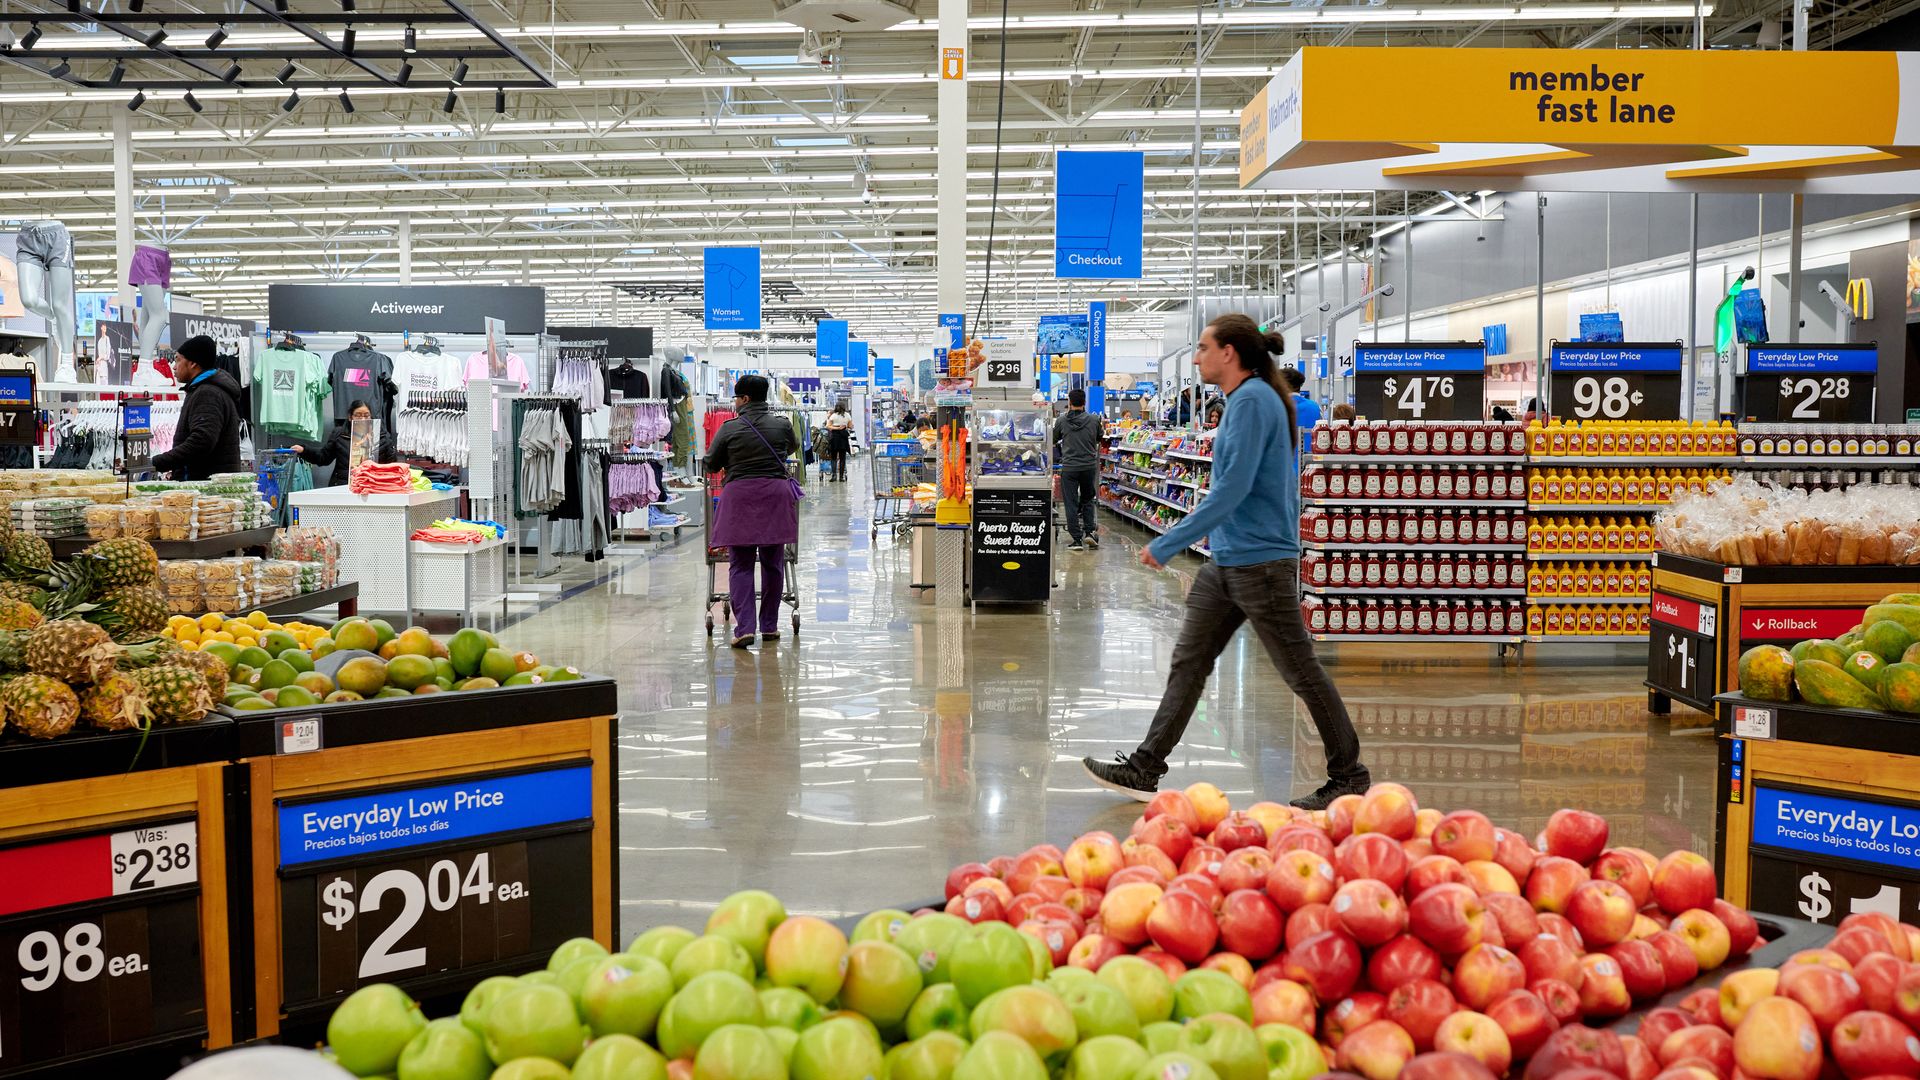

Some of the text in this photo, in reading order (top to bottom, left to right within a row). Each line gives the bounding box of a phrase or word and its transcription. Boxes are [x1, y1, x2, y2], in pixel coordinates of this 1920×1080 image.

[1508, 64, 1645, 92] member
[1537, 94, 1676, 123] fast lane
[1068, 254, 1122, 265] Checkout
[370, 301, 444, 314] Activewear
[1092, 310, 1101, 347] Checkout
[1339, 355, 1352, 367] 14
[1364, 352, 1445, 362] Everyday Low Price
[1560, 352, 1641, 362] Everyday Low Price
[1720, 351, 1729, 364] 35
[1758, 352, 1839, 362] Everyday Low Price
[1166, 380, 1171, 388] 9
[1183, 378, 1192, 386] 10
[978, 520, 1046, 535] Puerto Rican &
[983, 534, 1041, 546] Sweet Bread
[1661, 602, 1678, 617] Rollback
[1768, 618, 1818, 630] Rollback
[303, 788, 504, 834] Everyday Low Price
[1777, 800, 1920, 839] Everyday Lo
[134, 829, 167, 844] Was:
[304, 820, 450, 851] Precios bajos todos los días
[1777, 825, 1820, 842] Precios
[1823, 832, 1852, 847] bajos
[1855, 838, 1890, 852] todos
[1893, 842, 1911, 855] los
[497, 881, 529, 902] ea.
[18, 922, 149, 991] 98 ea.
